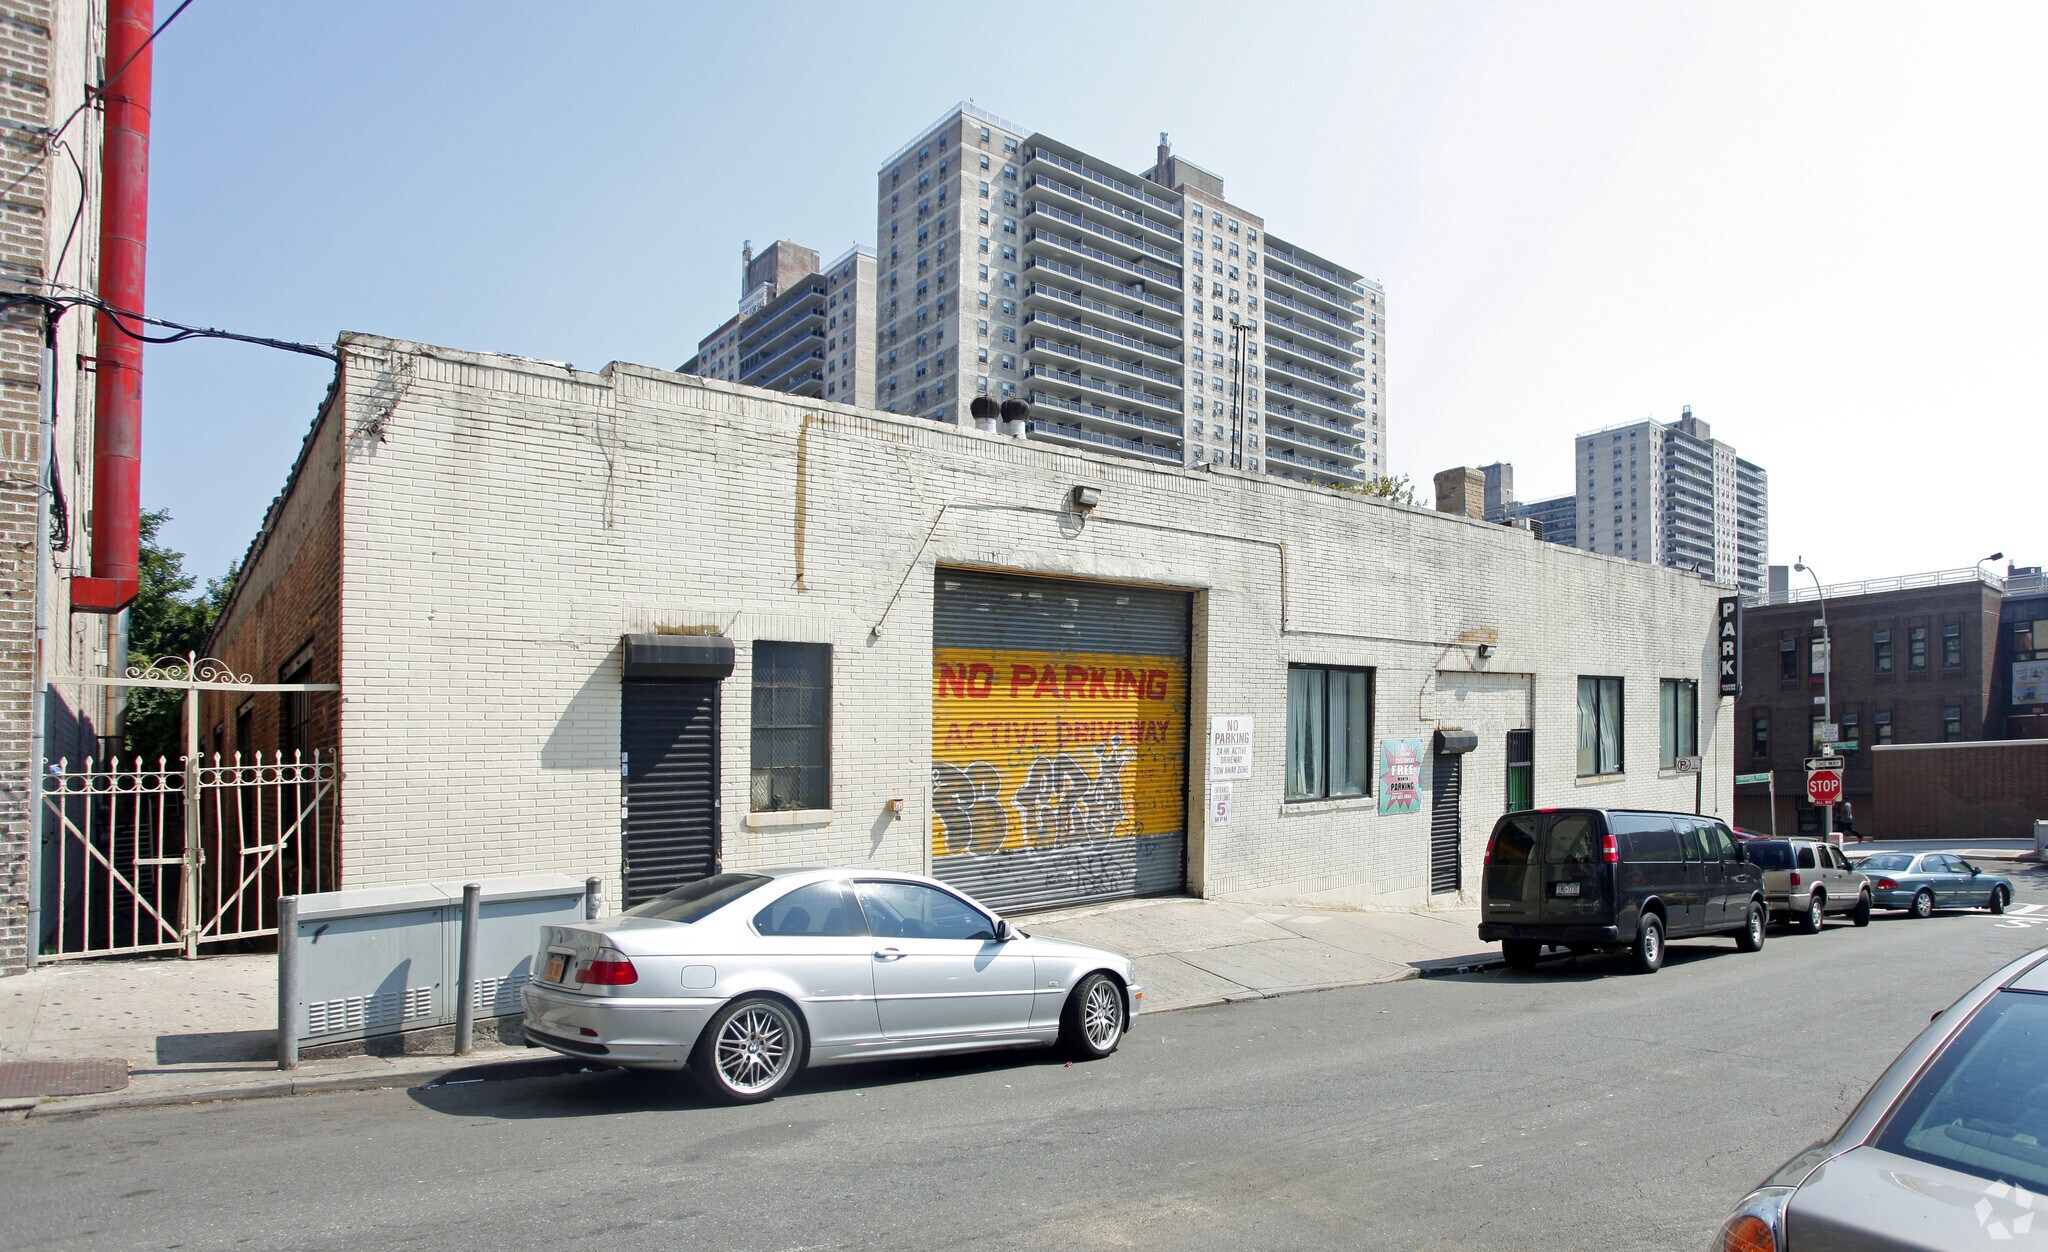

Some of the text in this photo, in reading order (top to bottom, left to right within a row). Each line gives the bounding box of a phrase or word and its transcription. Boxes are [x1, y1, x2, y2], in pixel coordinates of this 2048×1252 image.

[1721, 602, 1736, 676] PARK
[937, 661, 1169, 700] NO PARKING
[1227, 720, 1238, 731] NO
[944, 720, 1170, 749] ACTIVE DRIVEWAY
[1214, 732, 1249, 745] PARKING
[1216, 747, 1223, 755] 24
[1231, 746, 1247, 755] ACTIVE
[1220, 756, 1243, 764] DRIVEWAY
[1213, 765, 1249, 775] TOW AWAY ZONE
[1391, 765, 1415, 776] FREE
[1391, 782, 1414, 791] PARKING
[1810, 780, 1838, 793] STOP
[1216, 802, 1226, 816] 5
